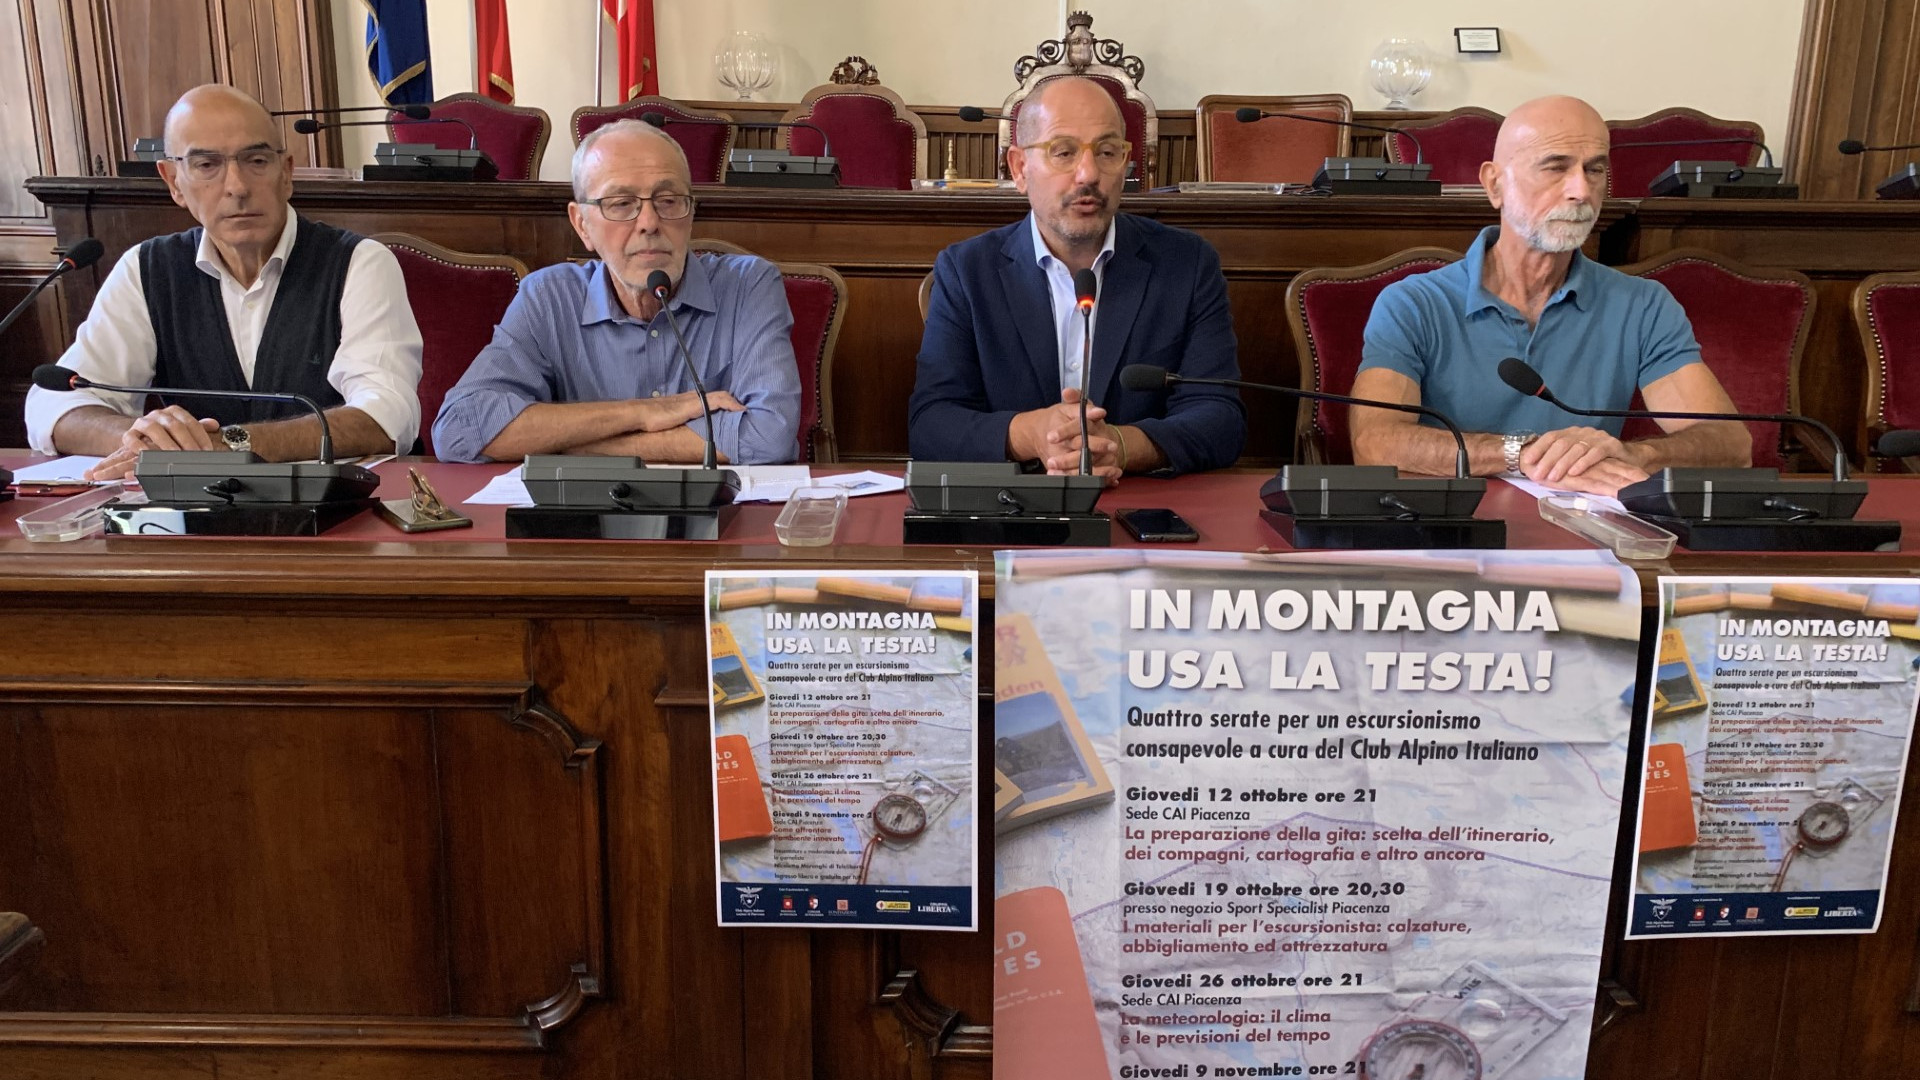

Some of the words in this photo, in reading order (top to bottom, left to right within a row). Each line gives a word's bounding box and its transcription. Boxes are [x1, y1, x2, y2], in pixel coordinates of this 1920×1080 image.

[1129, 589, 1190, 630] IN
[1208, 590, 1559, 632] MONTAGNA
[767, 613, 791, 629] IN
[800, 613, 937, 630] MONTAGNA
[1720, 619, 1745, 636] IN
[1751, 620, 1890, 637] MONTAGNA
[767, 637, 814, 653] USA
[824, 637, 851, 653] LA
[862, 636, 936, 653] TESTA!
[1717, 644, 1764, 660] USA
[1774, 645, 1802, 660] LA
[1813, 645, 1888, 661] TESTA!
[768, 661, 799, 669] Quattro
[829, 663, 841, 671] per
[856, 661, 909, 669] escursionismo
[1127, 651, 1243, 689] USA
[1270, 652, 1339, 690] LA
[1366, 651, 1552, 691] TESTA!
[1716, 668, 1746, 677] Quattro
[1777, 669, 1789, 679] per
[1804, 668, 1857, 677] escursionismo
[768, 674, 816, 684] consapevole
[845, 674, 856, 682] del
[859, 674, 875, 682] Club
[878, 674, 901, 684] Alpino
[781, 710, 829, 718] preparazione
[1128, 706, 1202, 727] Quattro
[1211, 711, 1270, 728] serate
[1278, 715, 1309, 734] per
[1317, 715, 1339, 728] un
[1346, 710, 1480, 729] escursionismo
[824, 719, 864, 727] cartografia
[1127, 738, 1243, 763] consapevole
[1250, 745, 1261, 758] a
[1269, 745, 1308, 758] cura
[1315, 738, 1344, 759] del
[1351, 739, 1390, 759] Club
[1398, 739, 1458, 765] Alpino
[1466, 740, 1538, 760] Italiano
[1127, 787, 1198, 801] Giovedi
[1209, 788, 1232, 801] 12
[1240, 788, 1307, 802] ottobre
[1315, 791, 1345, 802] ore
[1354, 789, 1376, 802] 21
[1126, 807, 1158, 819] Sede
[1163, 808, 1185, 820] CAI
[1191, 808, 1250, 820] Piacenza
[1126, 826, 1144, 840] La
[1151, 826, 1270, 843] preparazione
[1277, 826, 1320, 841] della
[1327, 827, 1366, 844] gita:
[1373, 827, 1422, 841] scelta
[1428, 827, 1554, 844] dell'itinerario,
[1125, 846, 1151, 860] dei
[1158, 847, 1249, 864] compagni,
[1257, 846, 1354, 864] cartografia
[1361, 850, 1370, 860] e
[1377, 846, 1417, 860] altro
[1424, 851, 1485, 860] ancora
[1124, 882, 1194, 895] Giovedi
[1205, 883, 1228, 895] 19
[1236, 883, 1302, 896] ottobre
[1309, 886, 1339, 896] ore
[1347, 883, 1405, 898] 20,30
[1124, 904, 1165, 917] presso
[1171, 903, 1222, 917] negozio
[1227, 902, 1262, 917] Sport
[1267, 902, 1328, 917] Specialist
[1332, 902, 1389, 913] Piacenza
[1135, 920, 1211, 933] materiali
[1219, 923, 1247, 937] per
[1253, 920, 1381, 933] l'escursionista:
[1387, 919, 1472, 934] calzature,
[1123, 939, 1248, 956] abbigliamento
[1255, 939, 1275, 952] ed
[1282, 939, 1387, 952] attrezzatura
[1122, 974, 1191, 988] Giovedi
[1200, 975, 1224, 987] 26
[1231, 973, 1296, 987] ottobre
[1304, 976, 1332, 986] ore
[1340, 974, 1362, 986] 21
[1122, 993, 1152, 1005] Sede
[1157, 993, 1179, 1005] CAI
[1185, 993, 1241, 1005] Piacenza
[1121, 1013, 1139, 1025] La
[1147, 1010, 1265, 1027] meteorologia:
[1271, 1009, 1280, 1023] il
[1287, 1009, 1331, 1022] clima
[1121, 1034, 1130, 1044] e
[1137, 1031, 1150, 1044] le
[1157, 1030, 1239, 1047] previsioni
[1246, 1029, 1271, 1042] del
[1278, 1031, 1330, 1045] tempo
[1120, 1063, 1188, 1078] Giovedi
[1196, 1065, 1207, 1077] 9
[1215, 1063, 1302, 1077] novembre
[1309, 1064, 1337, 1074] ore
[1344, 1061, 1366, 1074] 21
